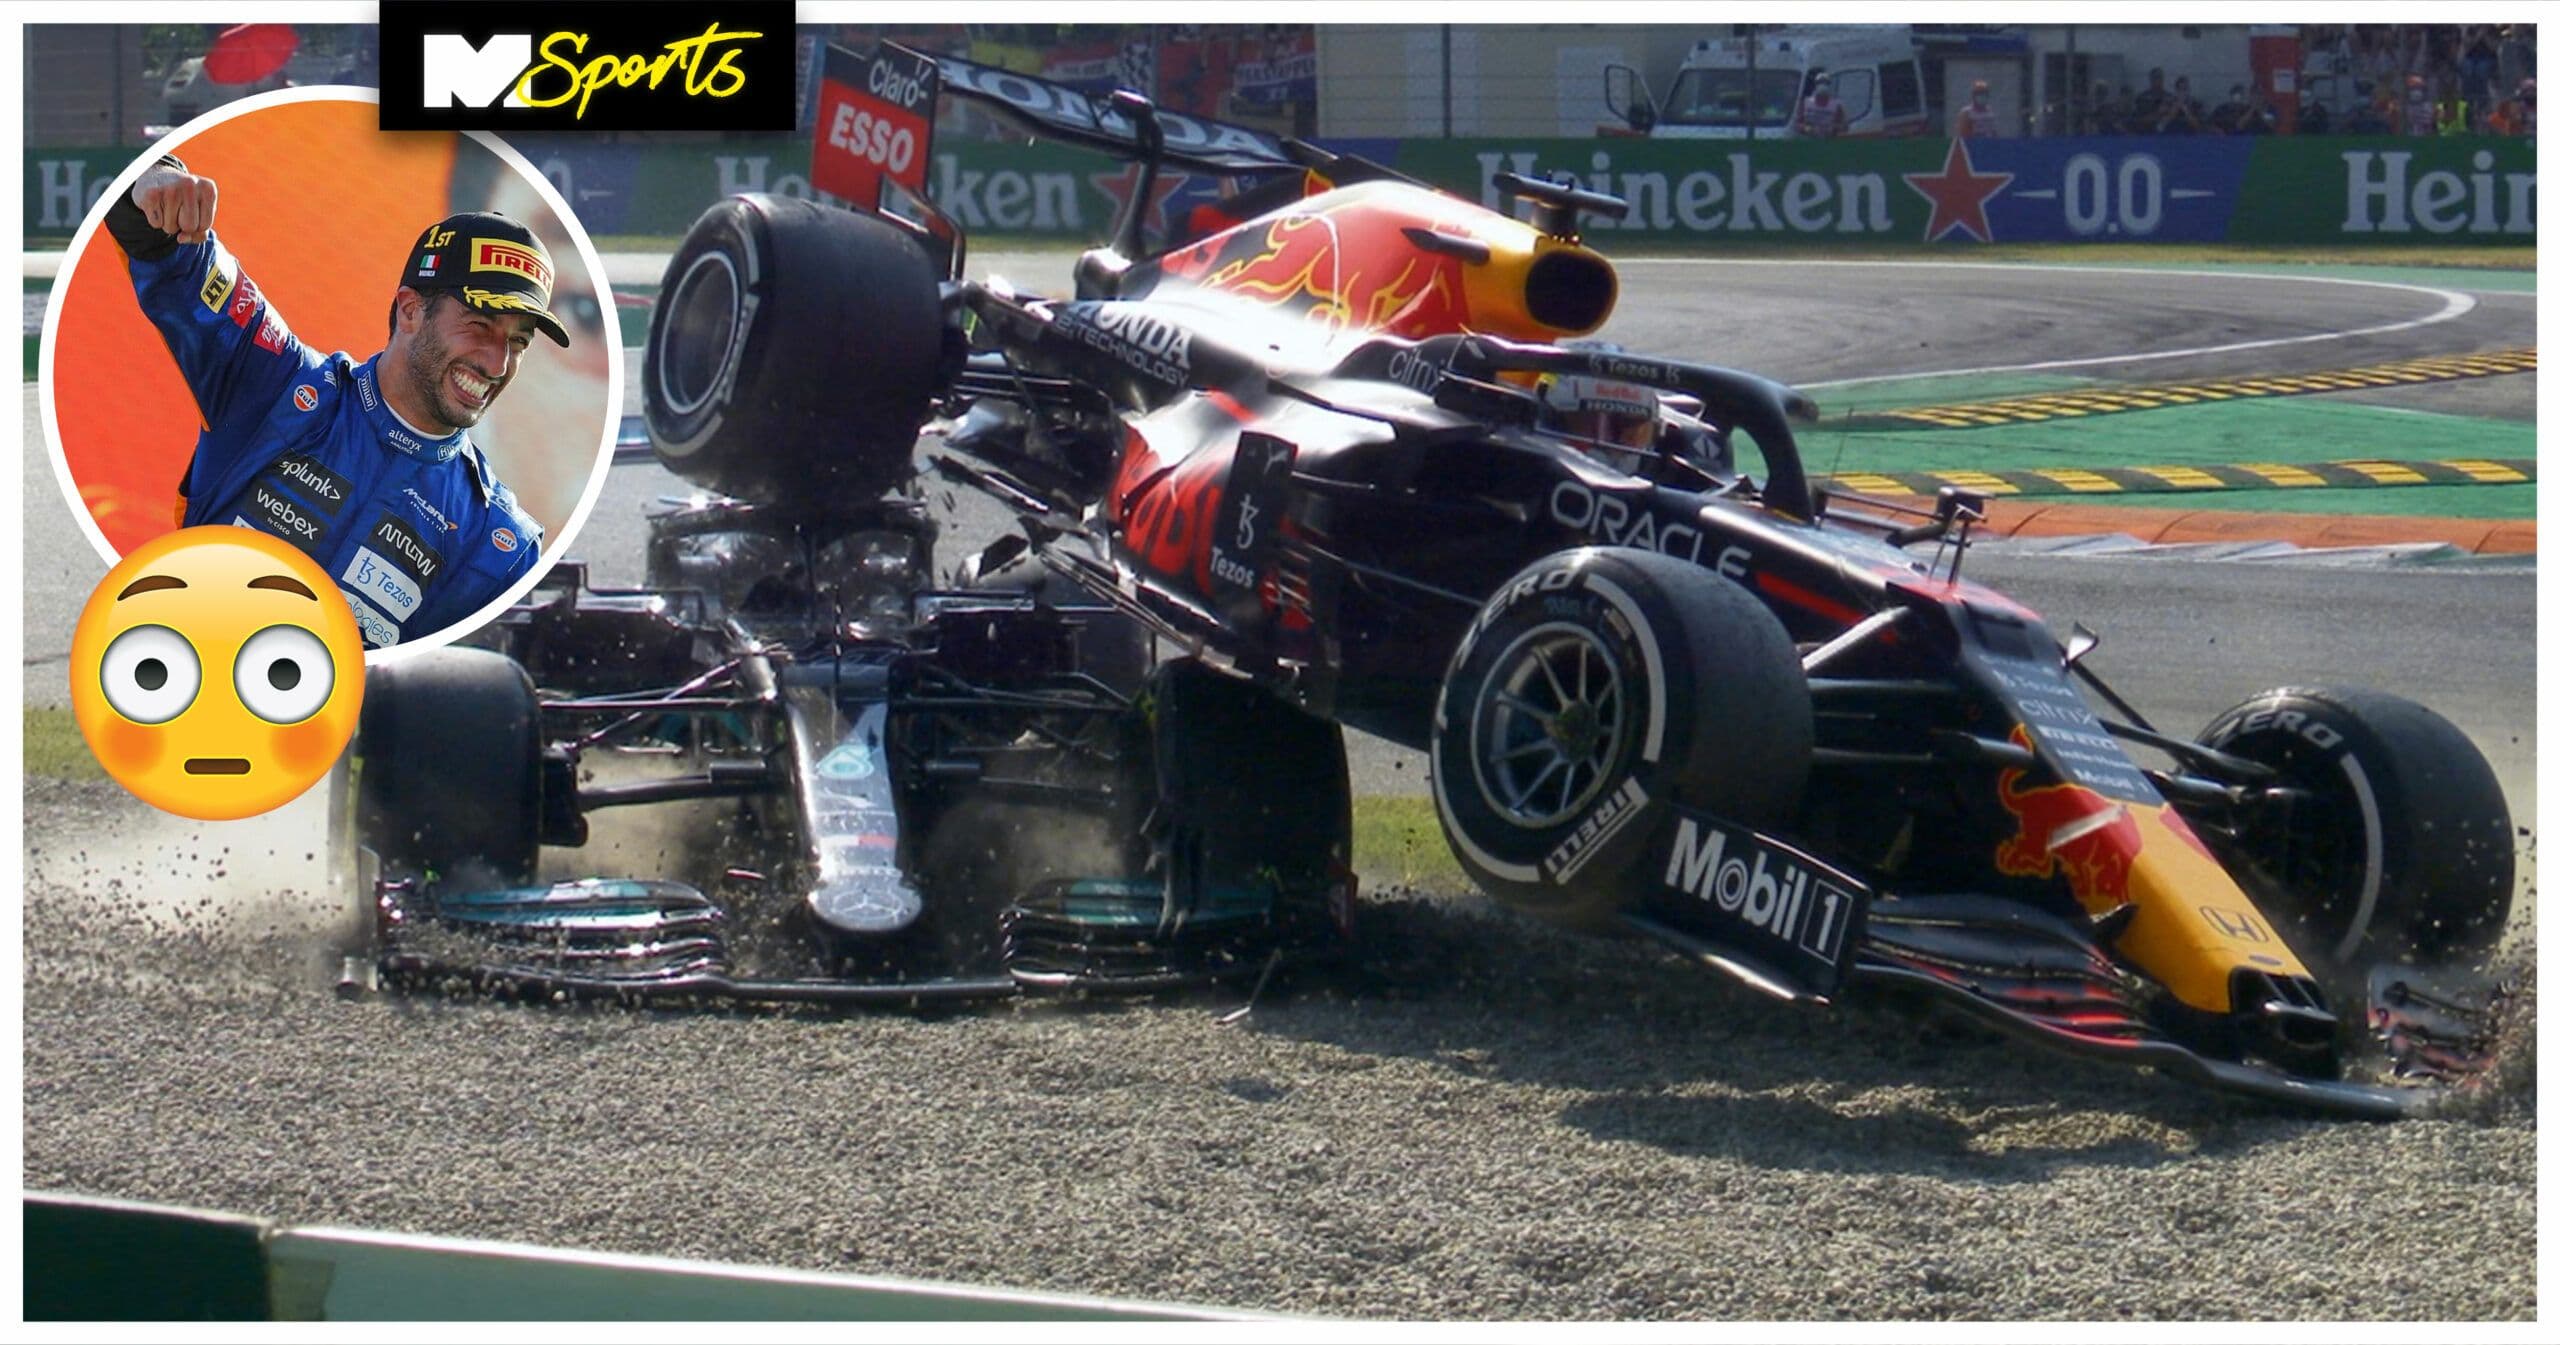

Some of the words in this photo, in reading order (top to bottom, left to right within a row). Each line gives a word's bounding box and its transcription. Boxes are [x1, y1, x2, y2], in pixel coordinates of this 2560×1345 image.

[830, 102, 914, 173] ESSO
[424, 225, 456, 249] 1ST
[296, 386, 316, 410] Gulf
[388, 428, 422, 452] alteryx
[256, 488, 319, 541] webex
[403, 487, 450, 532] McLaren
[493, 530, 517, 549] Gulf
[1210, 545, 1255, 589] Tezos
[376, 571, 414, 608] Tezos
[1543, 776, 1650, 886] PIRELLI
[1664, 816, 1809, 942] Mobil
